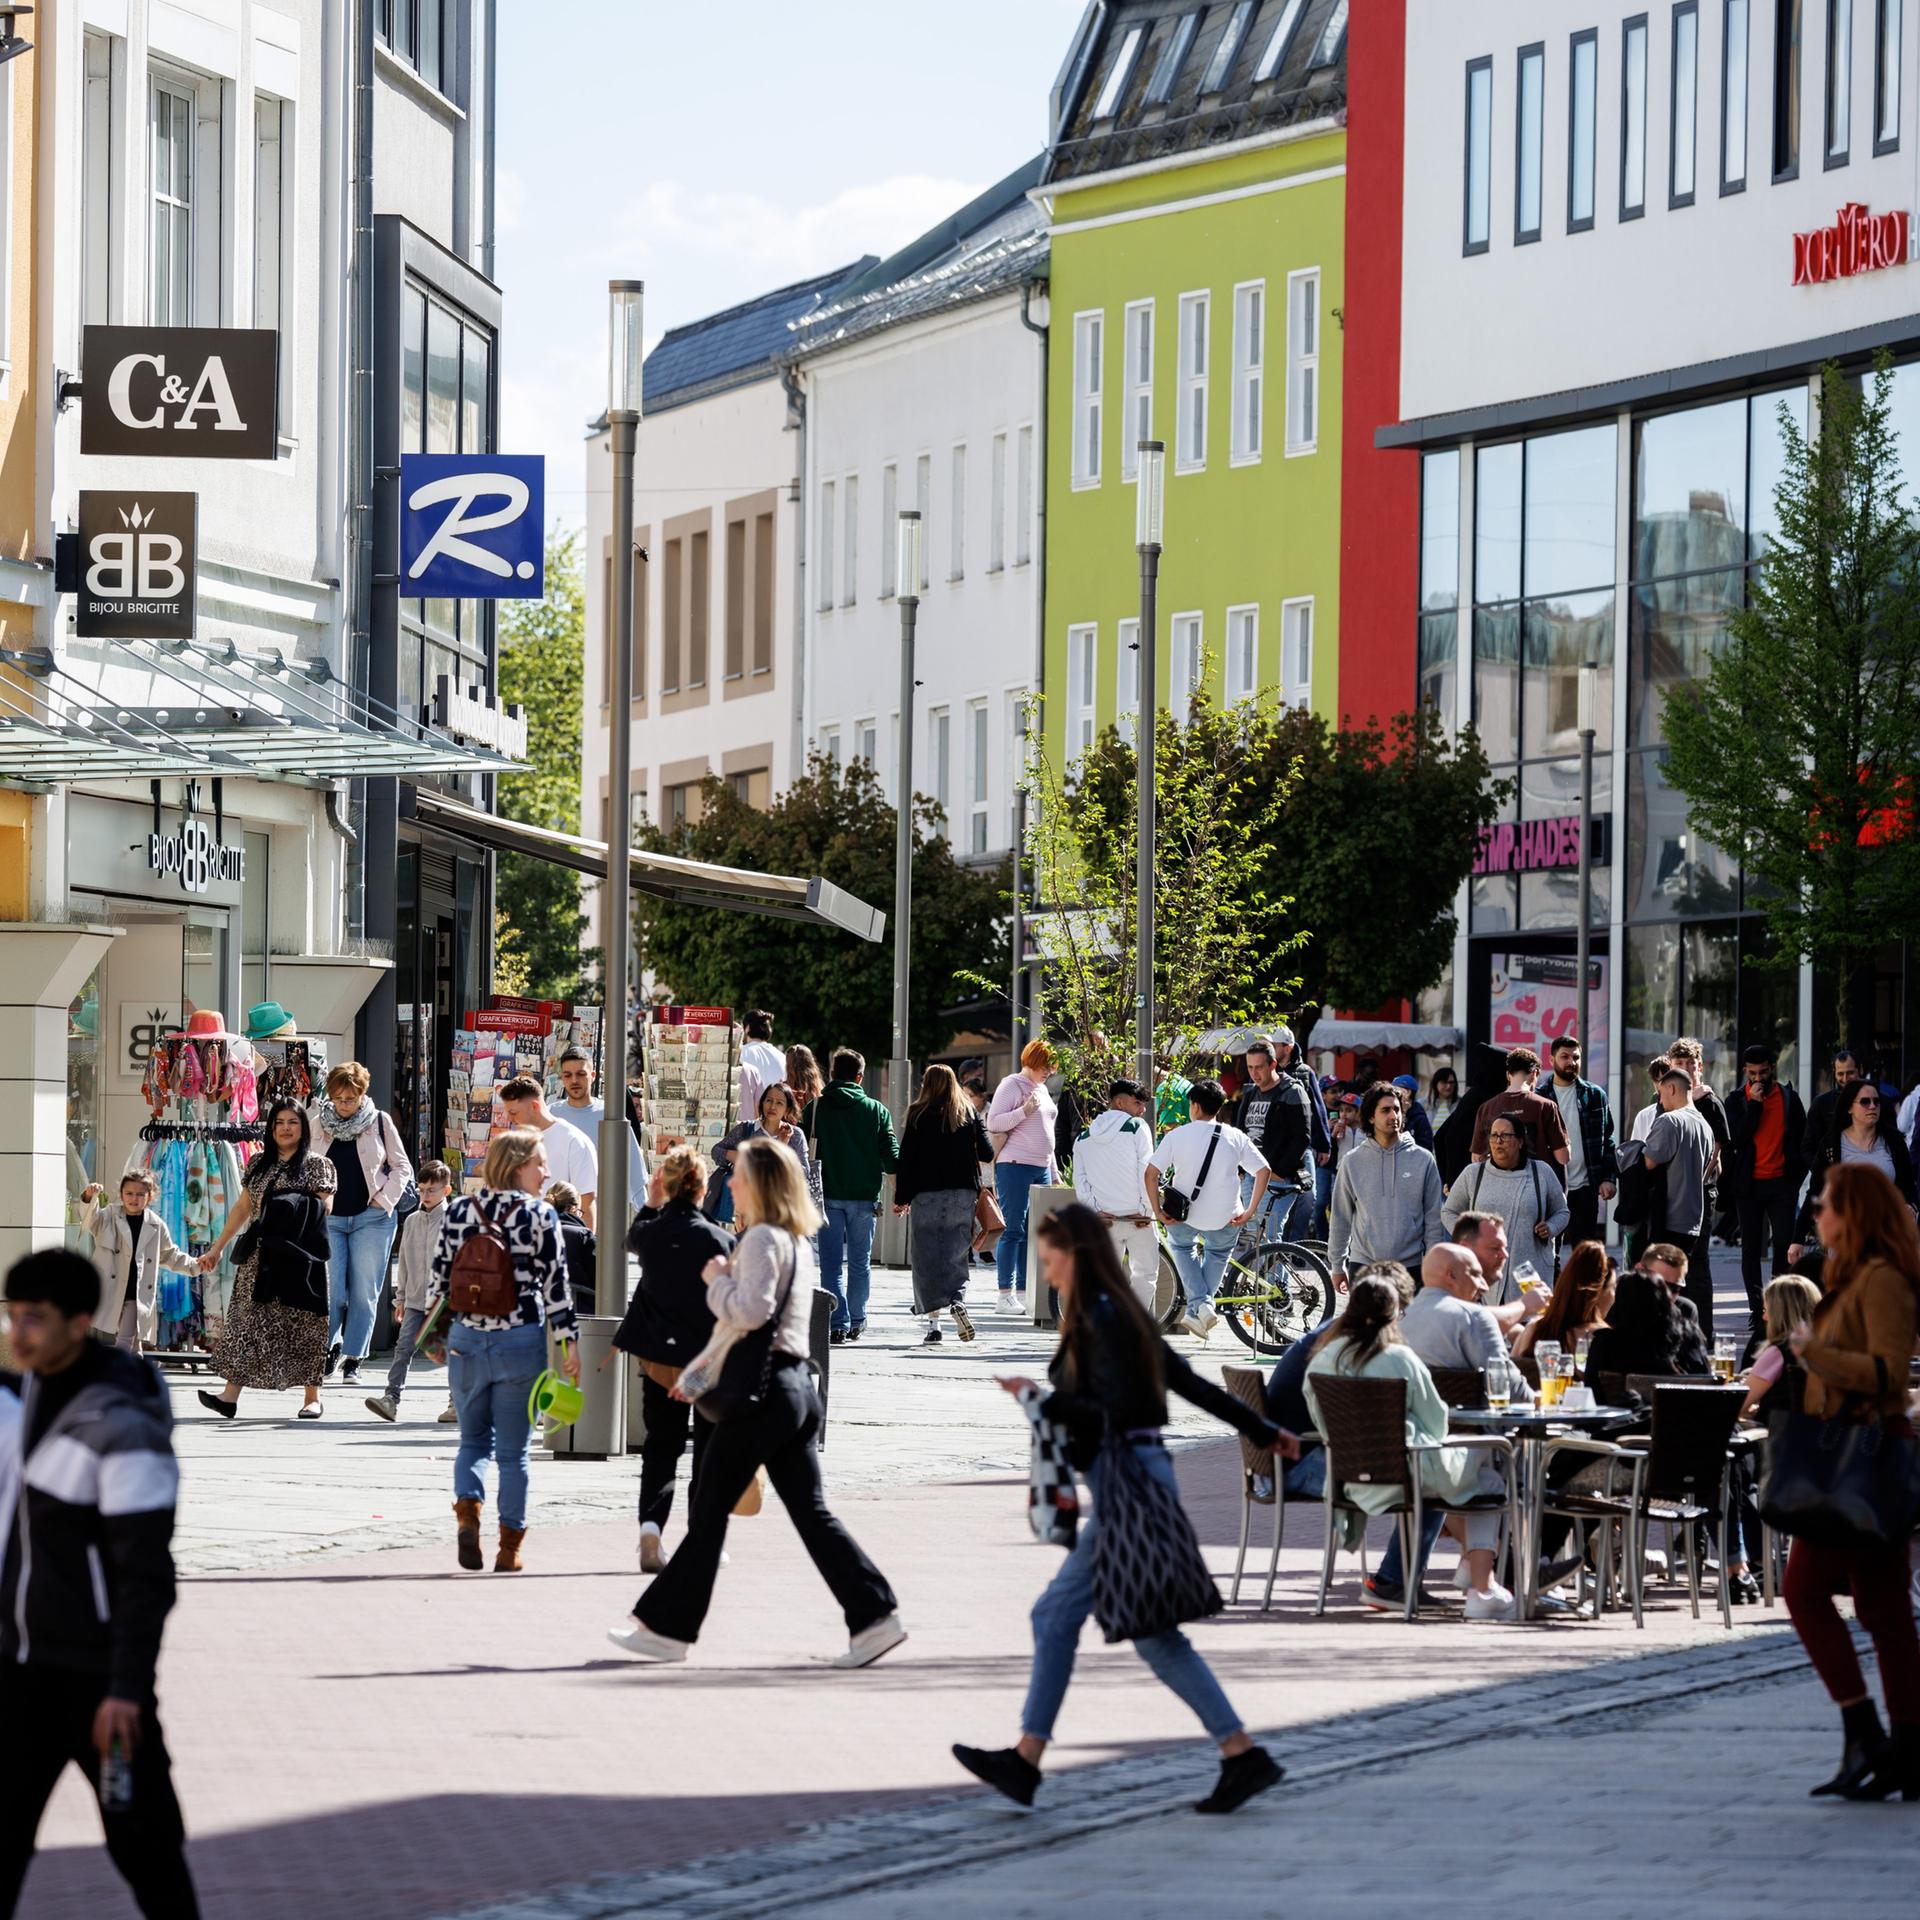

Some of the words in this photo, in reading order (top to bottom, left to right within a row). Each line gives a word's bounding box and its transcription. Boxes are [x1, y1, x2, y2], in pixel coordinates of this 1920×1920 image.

[1792, 203, 1901, 285] DORMERO
[108, 353, 248, 431] C&A
[89, 602, 124, 615] BIJOU
[127, 603, 180, 614] BRIGITTE
[152, 833, 183, 879] BIJOU
[501, 1016, 537, 1025] WERKSTATT
